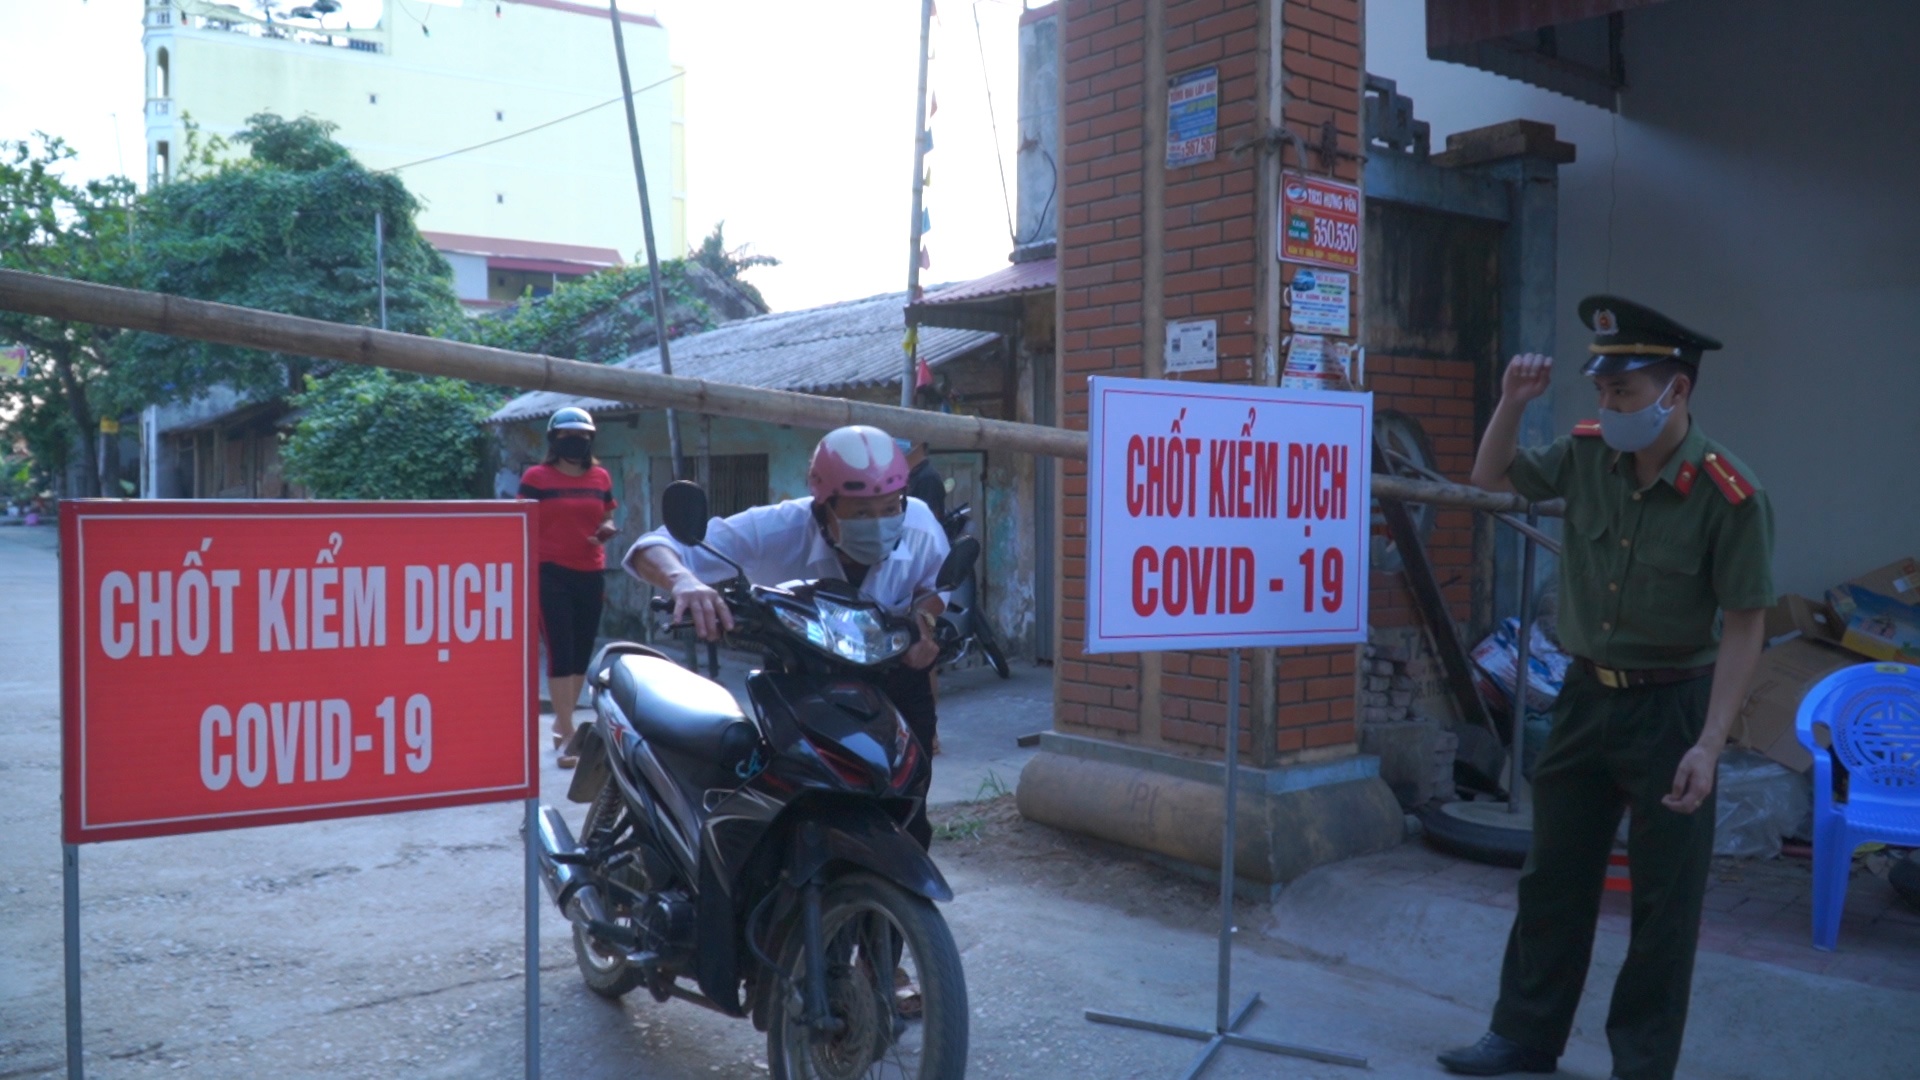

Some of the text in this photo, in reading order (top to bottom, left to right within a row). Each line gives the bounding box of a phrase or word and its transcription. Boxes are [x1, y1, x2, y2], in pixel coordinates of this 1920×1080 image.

[1313, 216, 1357, 253] 550.550
[1344, 193, 1357, 213] YÊN
[1126, 407, 1348, 537] CHỐT KIỂM DỊCH
[100, 532, 513, 662] CHỐT KIỂM DỊCH
[1131, 545, 1255, 617] COVID
[1299, 547, 1343, 613] 19
[200, 693, 433, 791] COVID-19
